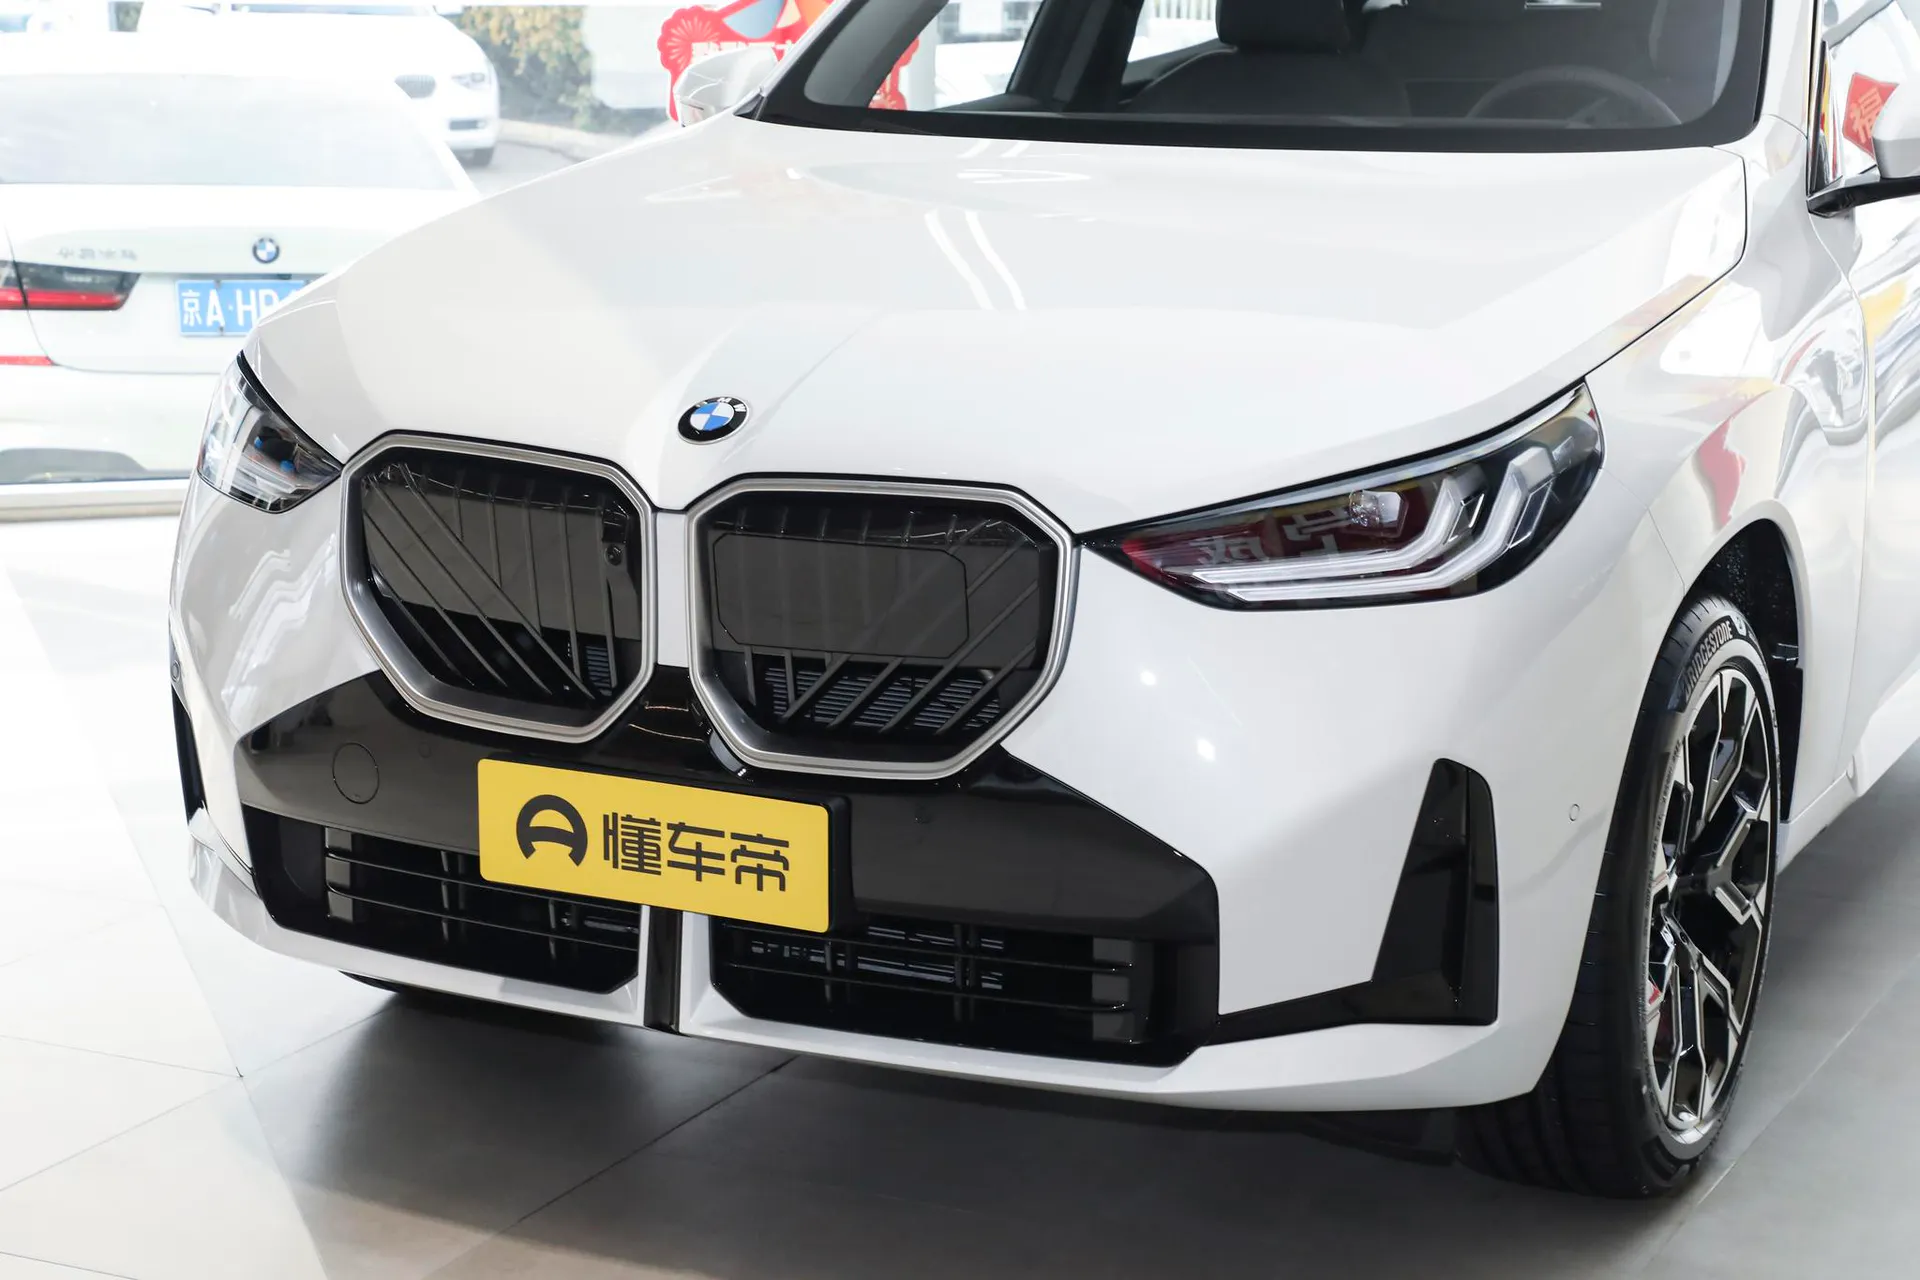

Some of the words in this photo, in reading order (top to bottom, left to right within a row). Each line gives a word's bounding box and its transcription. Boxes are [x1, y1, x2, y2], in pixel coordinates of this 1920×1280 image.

[181, 289, 299, 327] 京A·HP
[1684, 619, 1734, 703] BRIDGESTONE
[602, 812, 790, 893] 懂车帝
